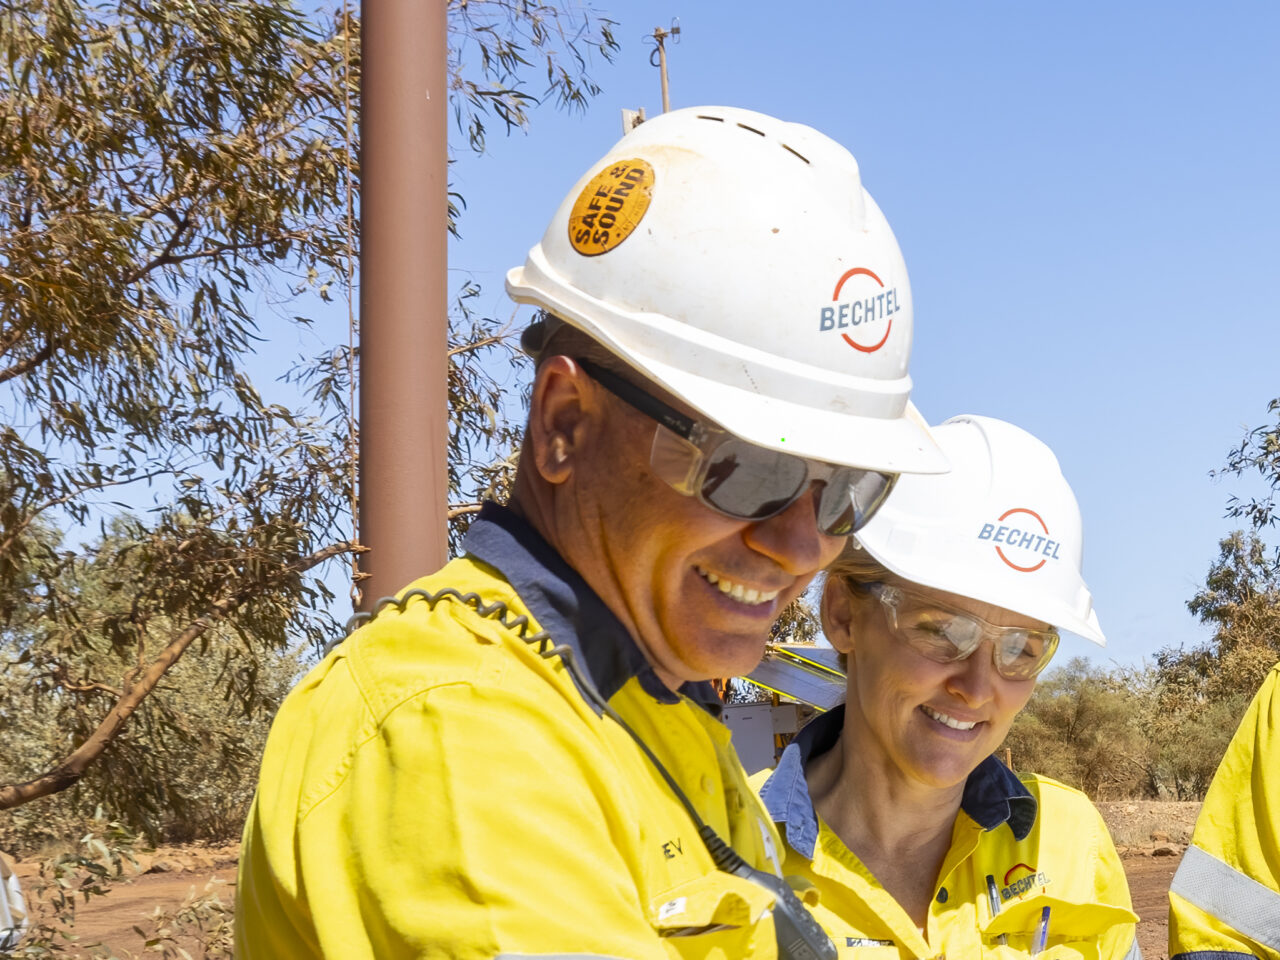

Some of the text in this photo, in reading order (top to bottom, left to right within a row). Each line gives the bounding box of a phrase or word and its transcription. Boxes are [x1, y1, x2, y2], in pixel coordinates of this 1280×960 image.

[574, 164, 630, 245] SAFE &
[592, 168, 645, 245] SOUND
[819, 287, 900, 332] BECHTEL
[978, 523, 1061, 560] BECHTEL
[1001, 872, 1051, 900] BECHTEL
